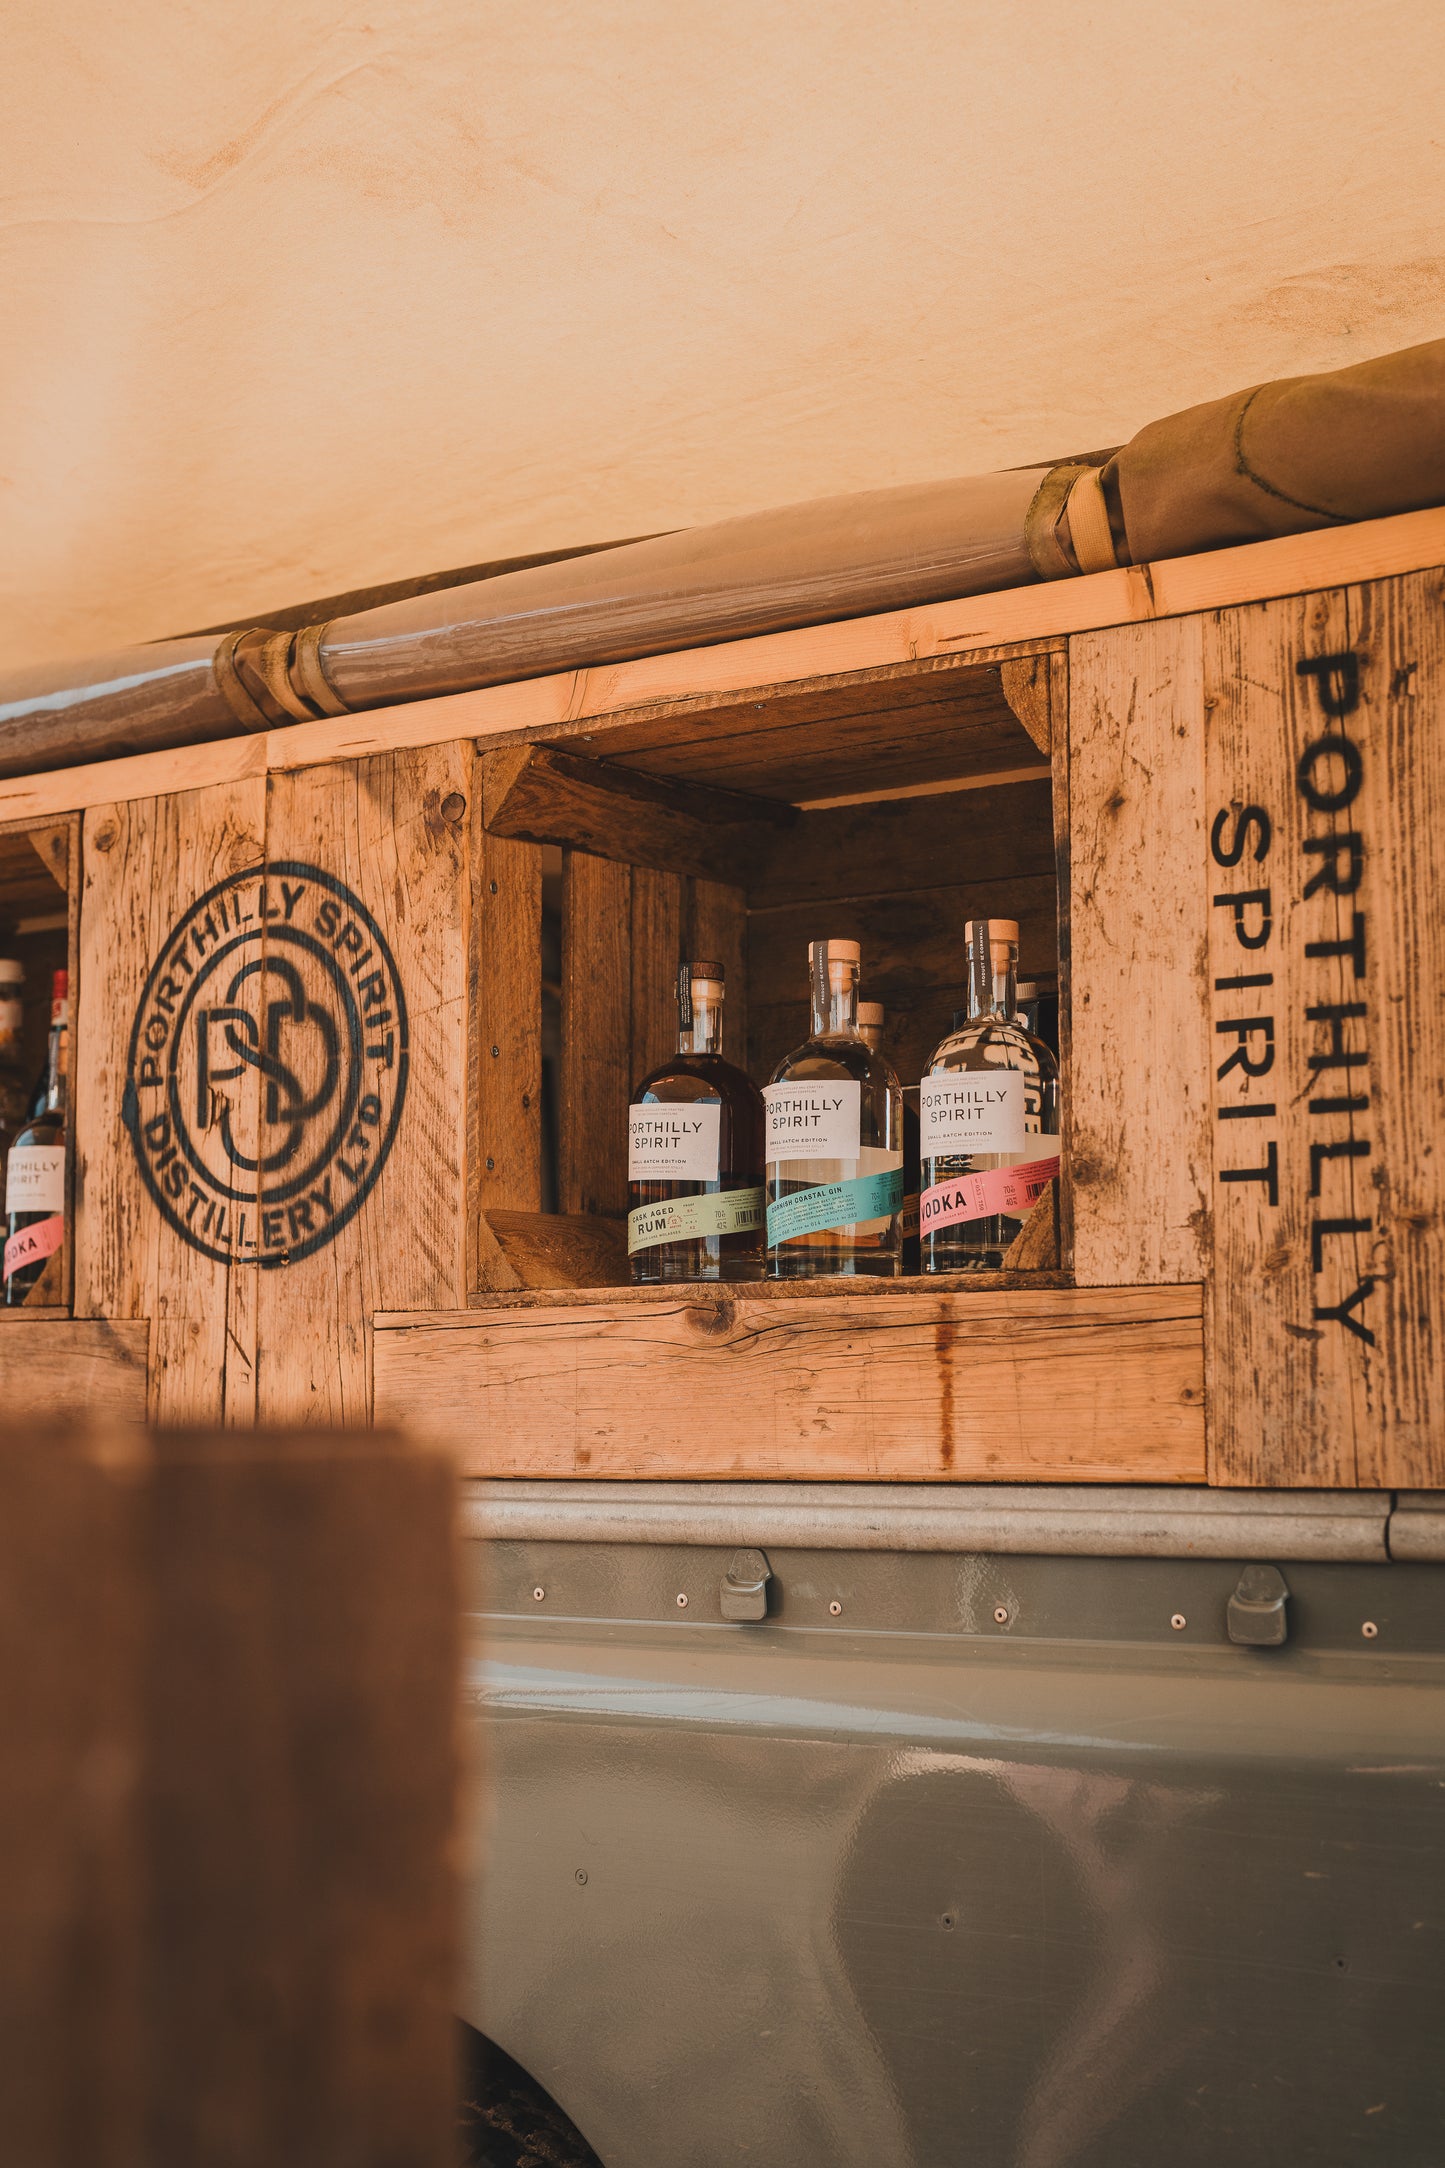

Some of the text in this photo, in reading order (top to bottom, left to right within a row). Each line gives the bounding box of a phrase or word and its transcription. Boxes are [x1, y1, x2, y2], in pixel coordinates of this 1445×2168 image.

[139, 881, 394, 1089] PORTHILLY SPIRIT
[1210, 805, 1279, 1207] SPIRIT
[1296, 651, 1375, 1348] PORTHILLY
[772, 1115, 821, 1130] SPIRIT
[930, 1107, 986, 1123] SPIRIT
[634, 1137, 681, 1149] SPIRIT
[144, 1093, 382, 1249] DISTILLERY LTD
[771, 1199, 793, 1214] CORNISH
[794, 1190, 827, 1204] COASTAL
[828, 1186, 843, 1195] GIN
[632, 1212, 648, 1223] CASK
[650, 1206, 674, 1218] AGED
[637, 1218, 667, 1236] RUM
